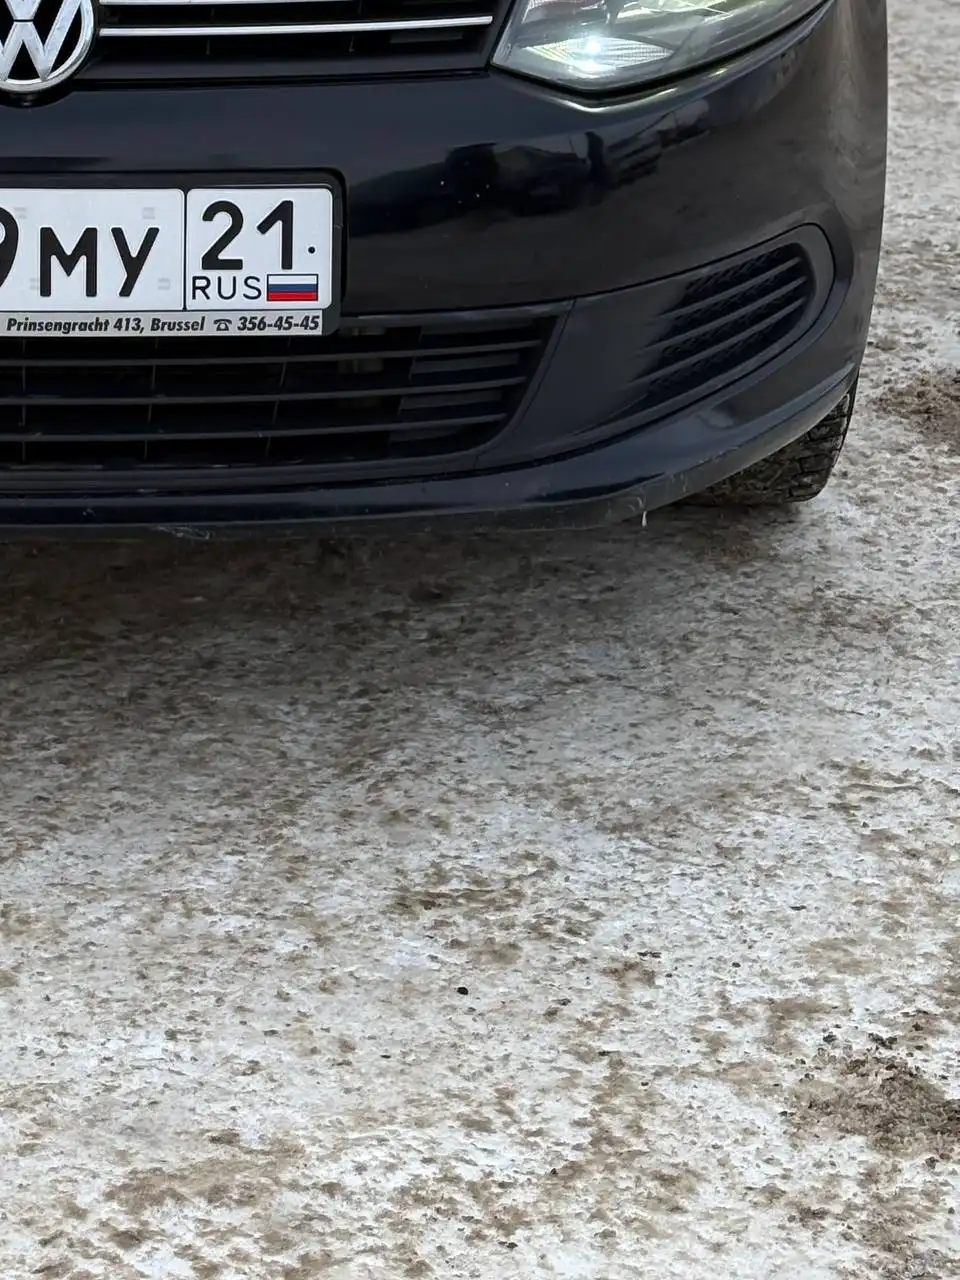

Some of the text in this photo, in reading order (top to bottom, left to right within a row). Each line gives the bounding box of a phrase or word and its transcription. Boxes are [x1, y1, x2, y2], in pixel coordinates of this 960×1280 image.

[200, 199, 294, 271] 21
[191, 275, 261, 301] RUS
[6, 317, 110, 334] Prinsengracht
[113, 316, 146, 334] 413,
[150, 316, 205, 332] Brussel
[237, 315, 320, 332] 356-45-45
